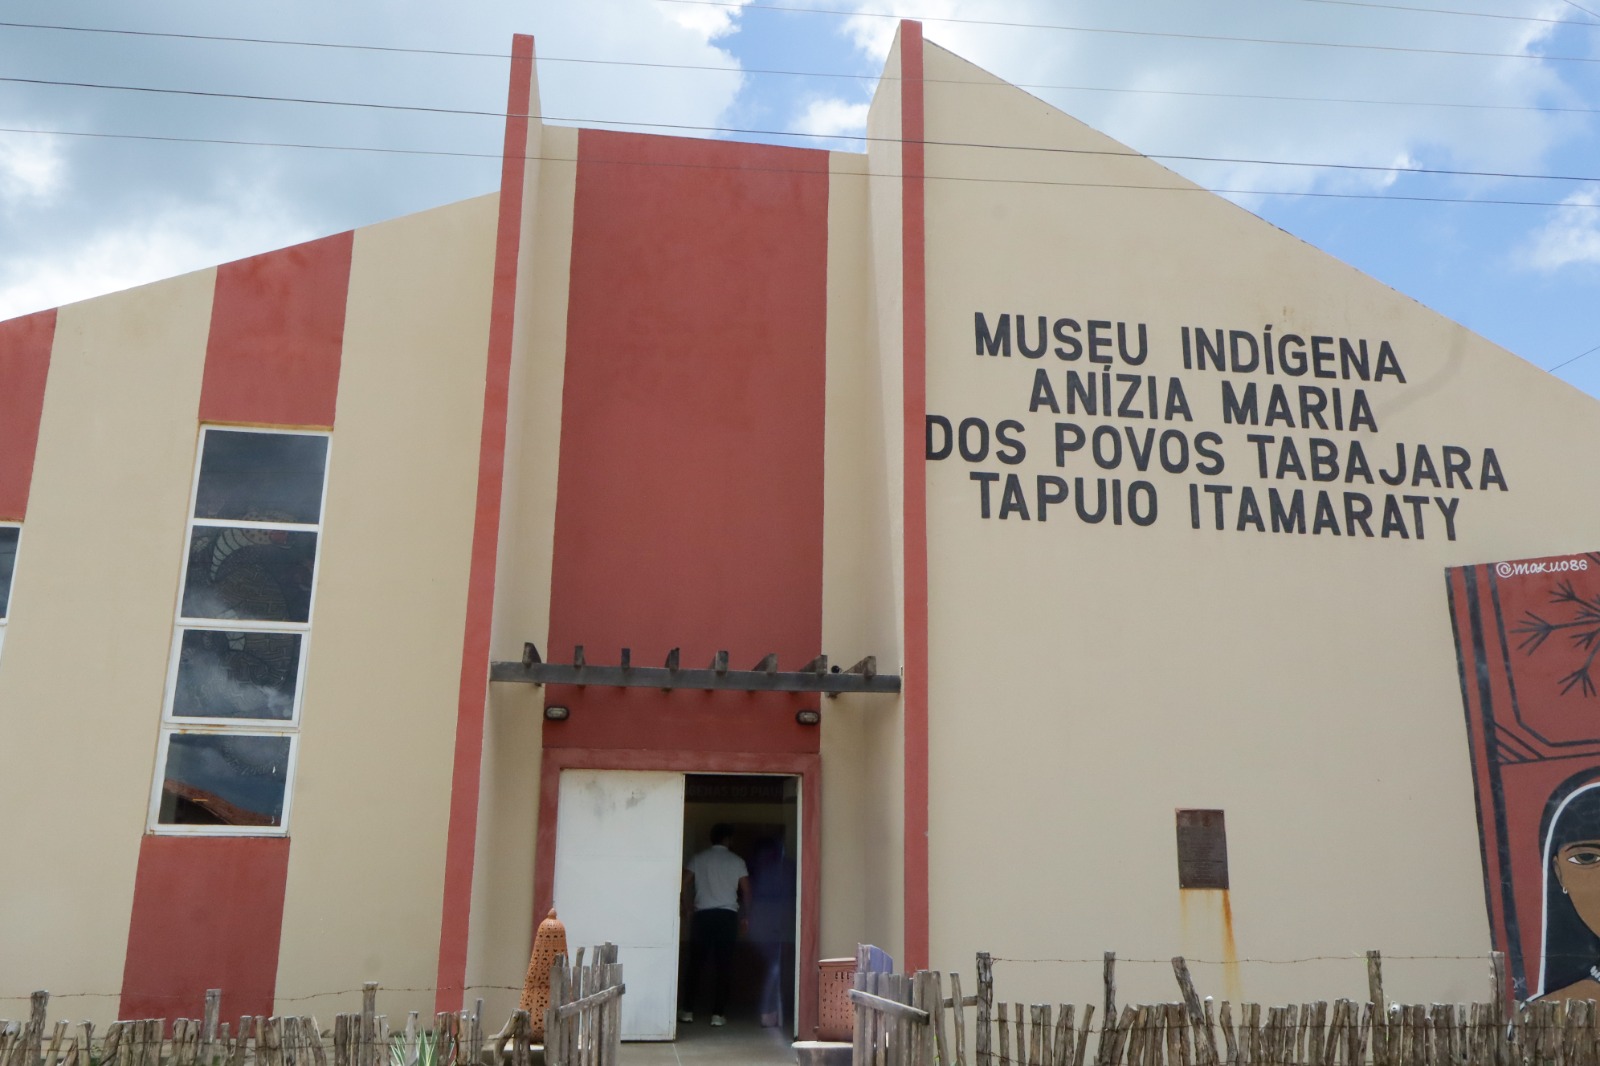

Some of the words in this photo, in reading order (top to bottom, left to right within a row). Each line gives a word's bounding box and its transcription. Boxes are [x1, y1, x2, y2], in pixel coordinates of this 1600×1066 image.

[974, 311, 1148, 366] MUSEU
[1181, 324, 1407, 384] INDÍGENA
[1028, 365, 1194, 422] ANÍZIA
[1221, 380, 1379, 433] MARIA
[925, 414, 1027, 465] DOS
[1054, 422, 1225, 476] POVOS
[1246, 433, 1509, 492] TABAJARA
[969, 471, 1158, 527] TAPUIO
[1189, 483, 1460, 541] ITAMARATY
